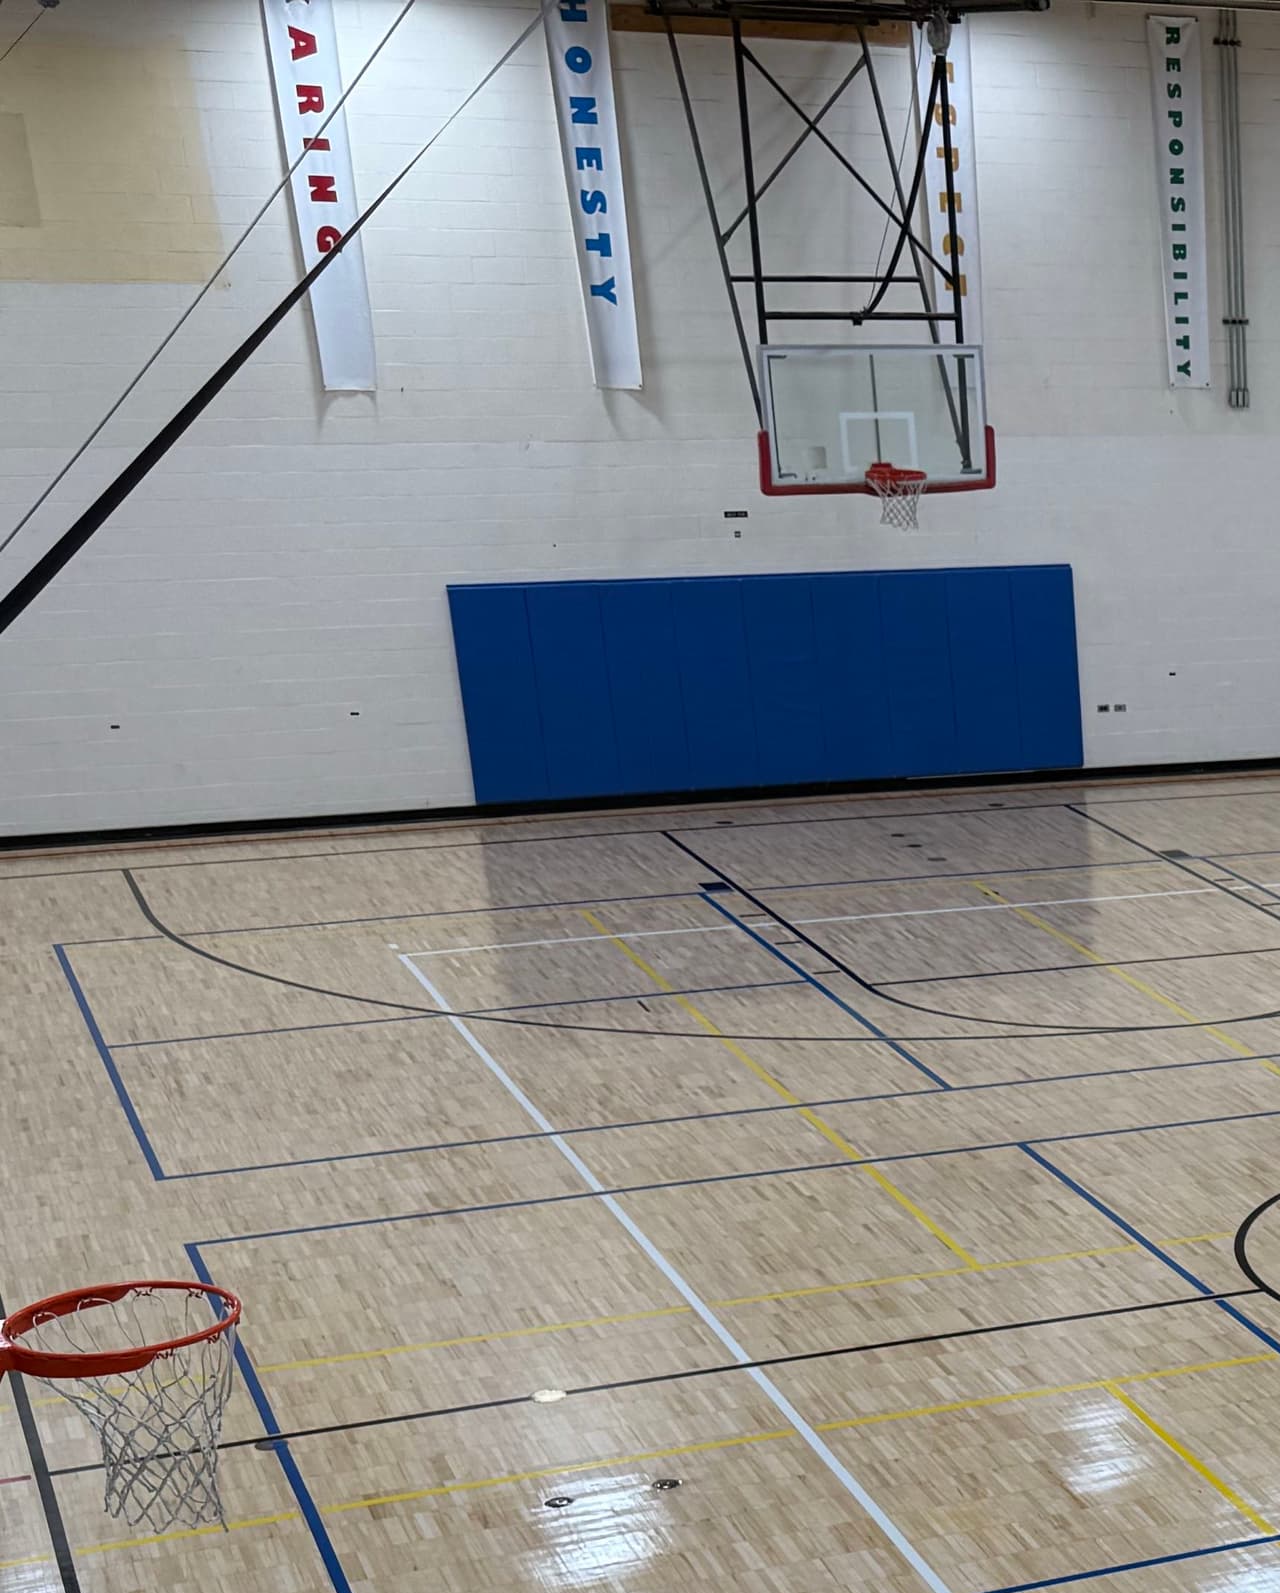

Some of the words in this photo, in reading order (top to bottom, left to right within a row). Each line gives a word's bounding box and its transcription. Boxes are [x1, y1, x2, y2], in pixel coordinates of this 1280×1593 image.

[284, 0, 344, 254] ARING
[560, 0, 618, 306] HONESTY
[1165, 26, 1192, 378] RESPONSIBILITY
